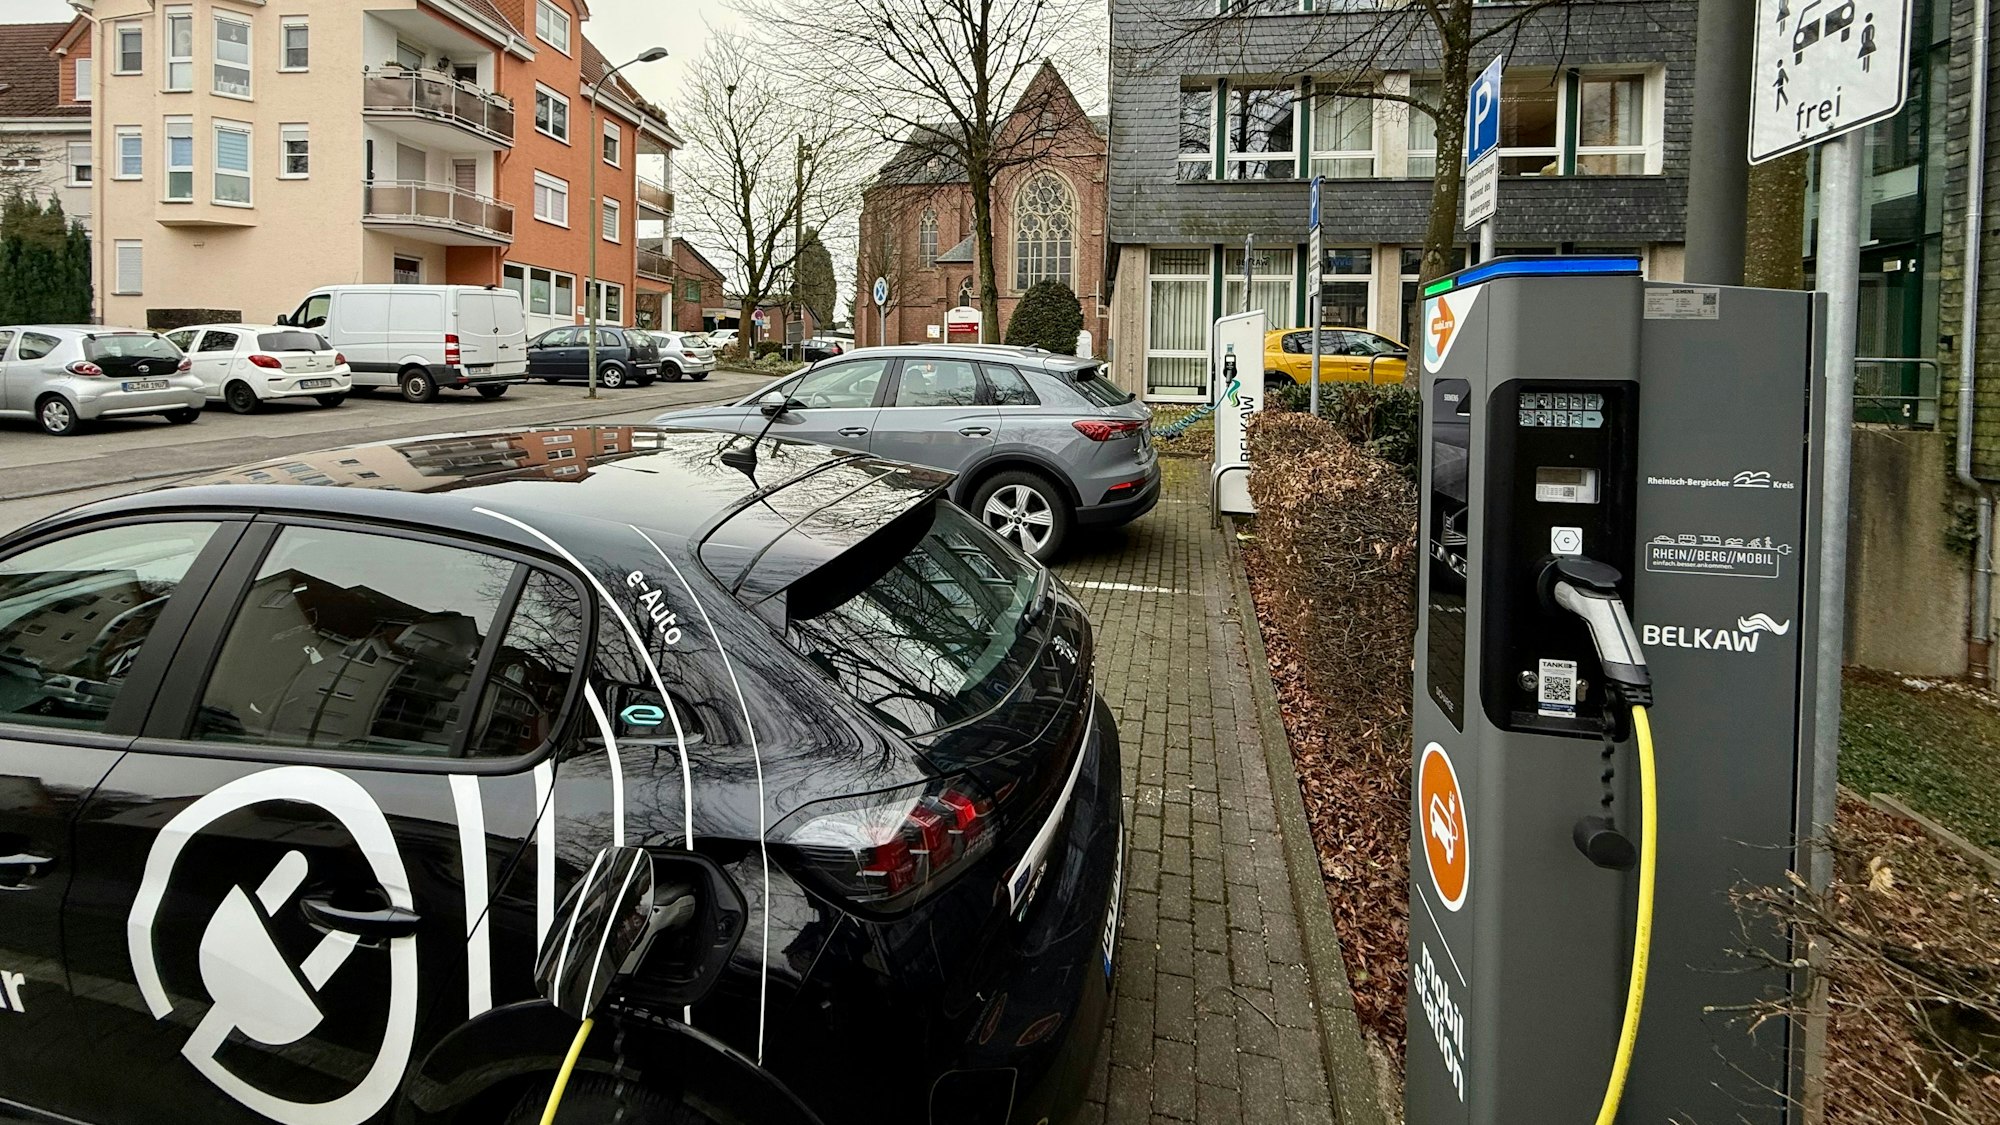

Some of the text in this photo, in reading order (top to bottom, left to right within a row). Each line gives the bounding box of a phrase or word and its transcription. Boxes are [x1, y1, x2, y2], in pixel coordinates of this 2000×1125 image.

[1473, 80, 1492, 150] P
[1796, 86, 1842, 132] frei
[1647, 476, 1794, 489] Rheinisch-Bergischer Kreis
[1652, 548, 1774, 565] RHEIN//BERG//MOBIL
[1652, 560, 1734, 570] einfach.besser.ankommen.
[626, 570, 682, 645] e-Auto
[1642, 624, 1760, 653] BELKAW
[0, 969, 26, 1013] r
[1421, 941, 1465, 1062] mobil
[1413, 962, 1464, 1103] station
